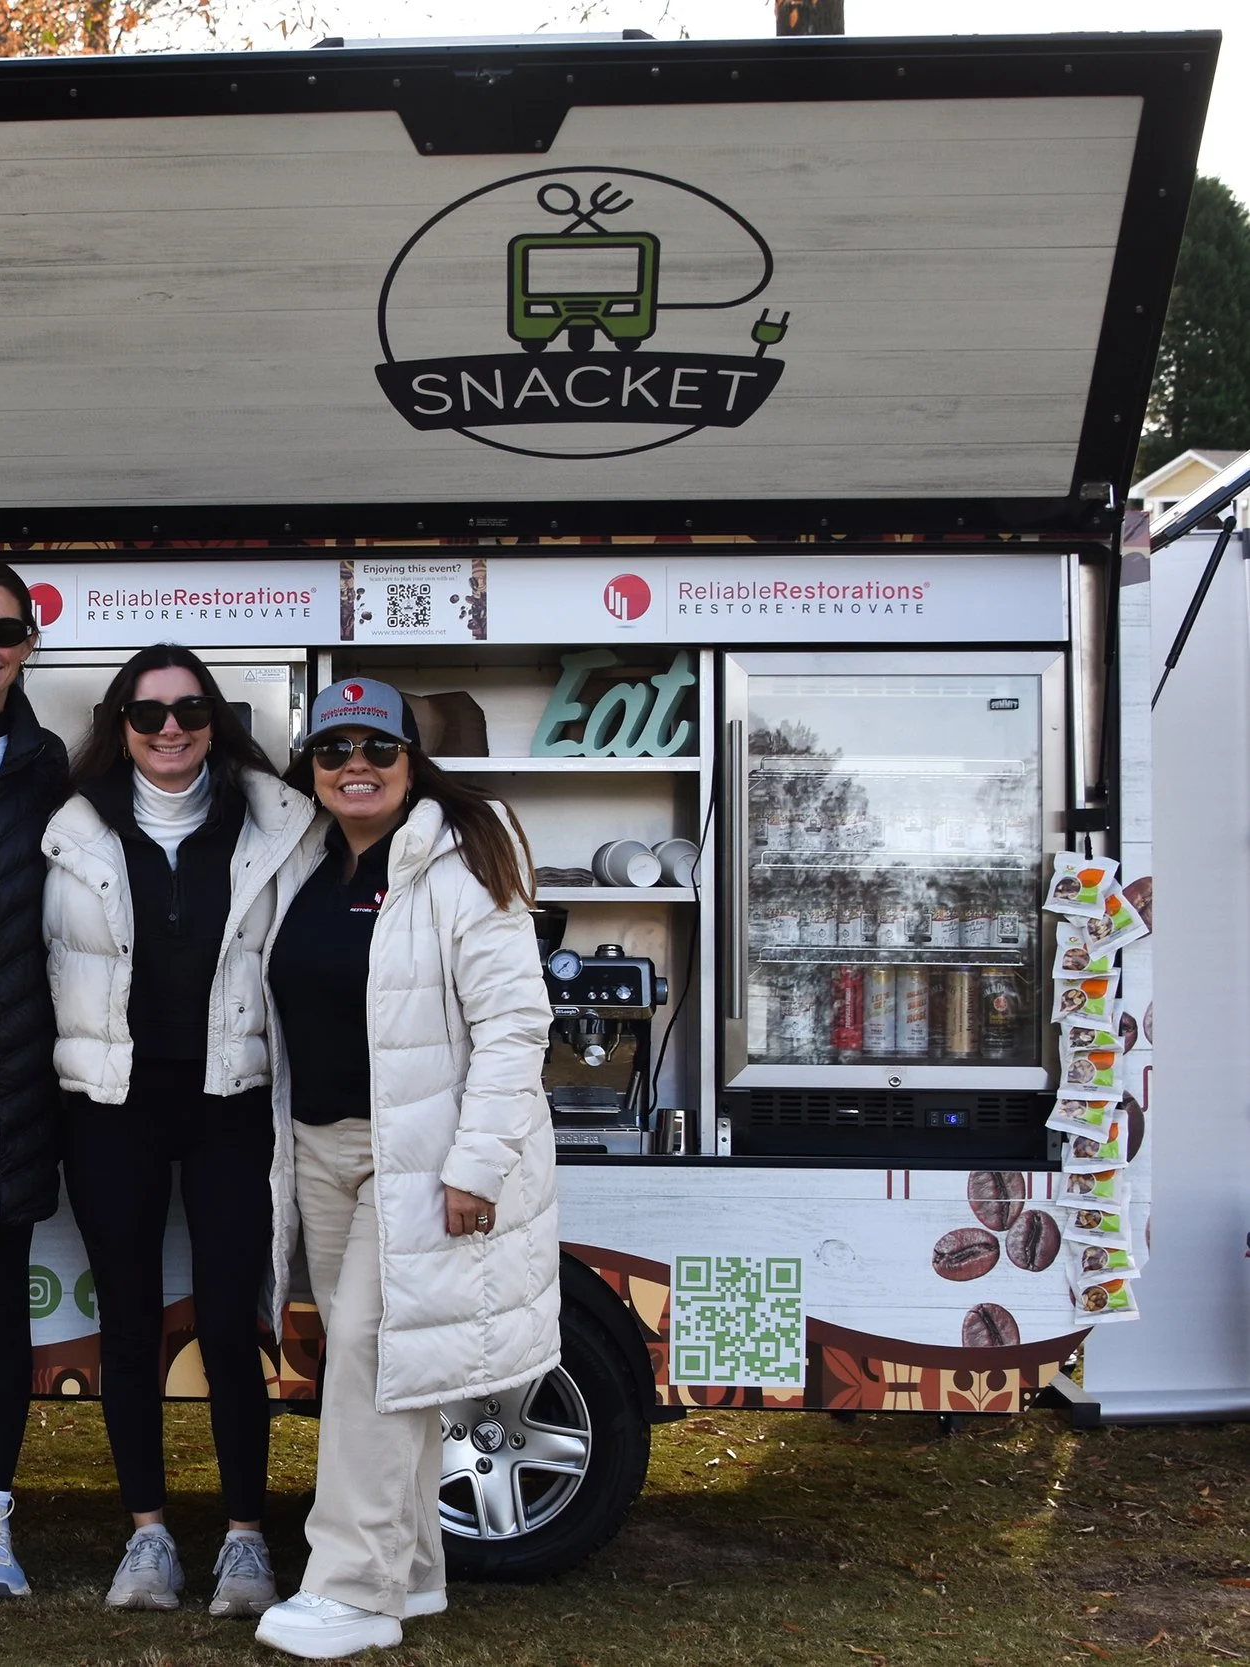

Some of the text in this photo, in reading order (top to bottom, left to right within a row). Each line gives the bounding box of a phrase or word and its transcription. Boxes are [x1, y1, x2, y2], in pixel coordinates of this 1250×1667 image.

[410, 365, 758, 415] SNACKET
[363, 563, 461, 574] Enjoying this event?
[530, 649, 696, 757] Eat
